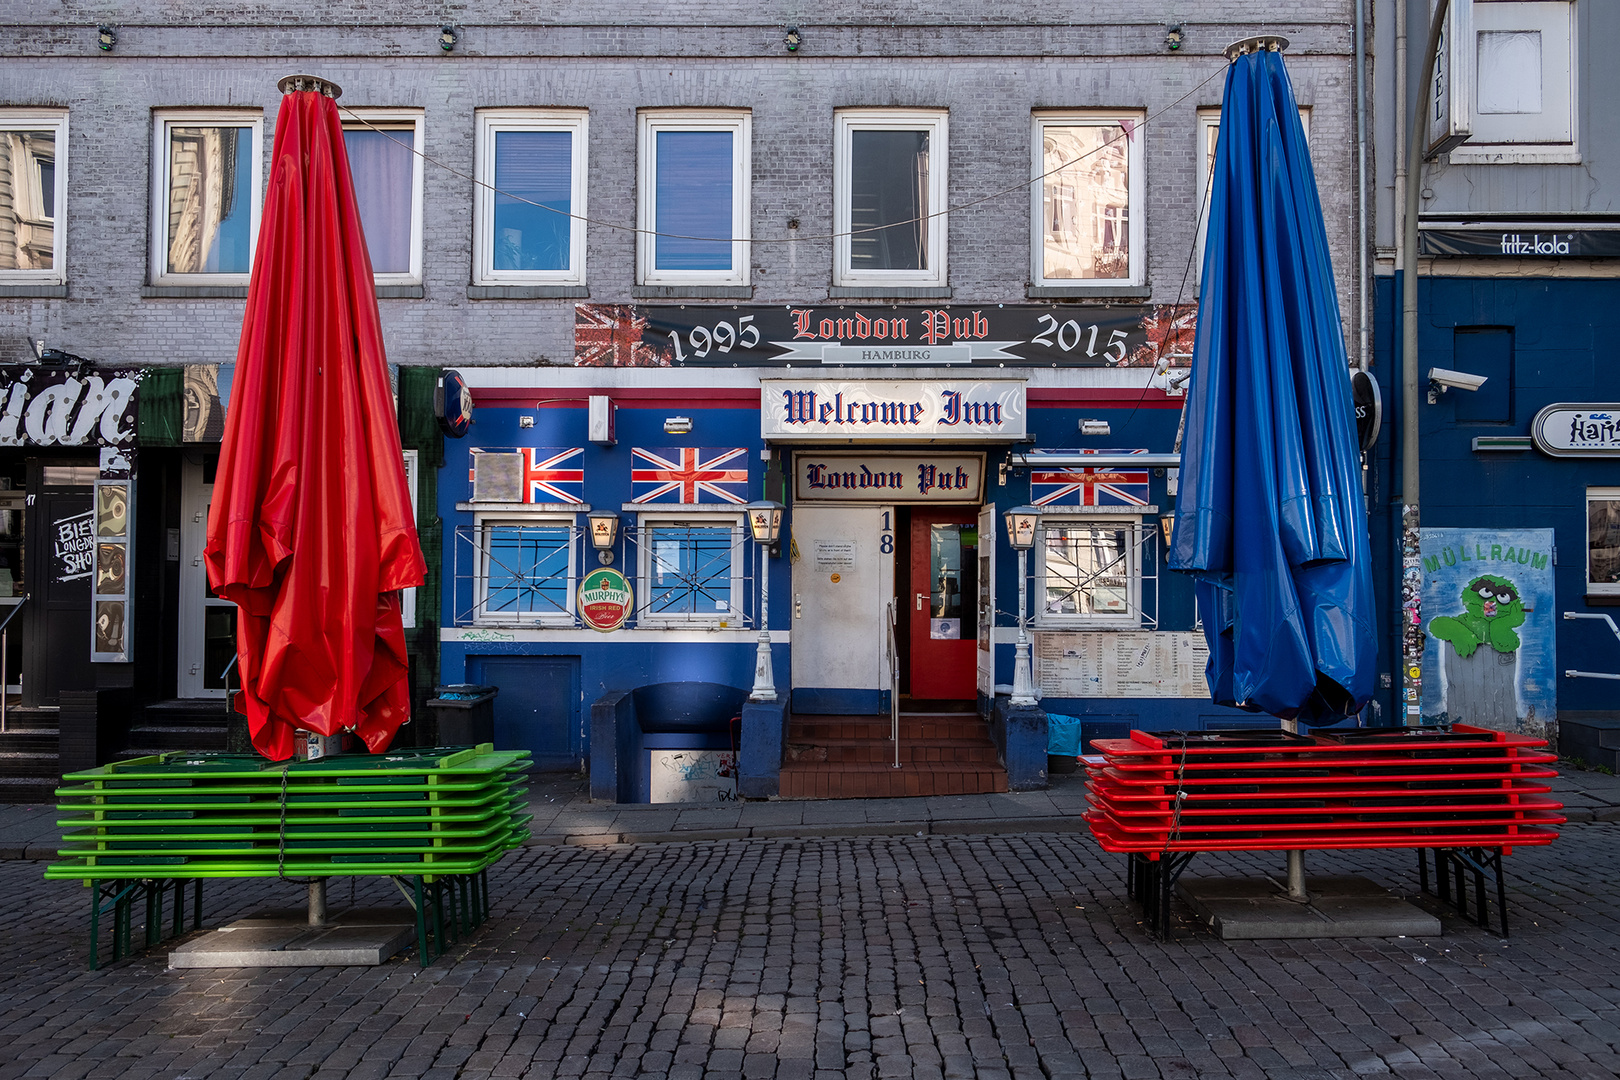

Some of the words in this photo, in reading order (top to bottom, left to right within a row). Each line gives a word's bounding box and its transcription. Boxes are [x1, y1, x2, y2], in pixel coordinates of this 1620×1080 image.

[667, 315, 760, 362] 1995
[790, 309, 909, 340] London
[919, 309, 989, 345] Pub
[1031, 313, 1129, 363] 2015
[862, 350, 931, 360] HAMBURG
[782, 389, 925, 426] Welcome
[937, 389, 1003, 426] Inn
[806, 463, 904, 490] London
[917, 463, 970, 496] Pub
[26, 494, 36, 506] 17
[880, 511, 894, 554] 18
[1423, 544, 1548, 573] MÜLLRAUM
